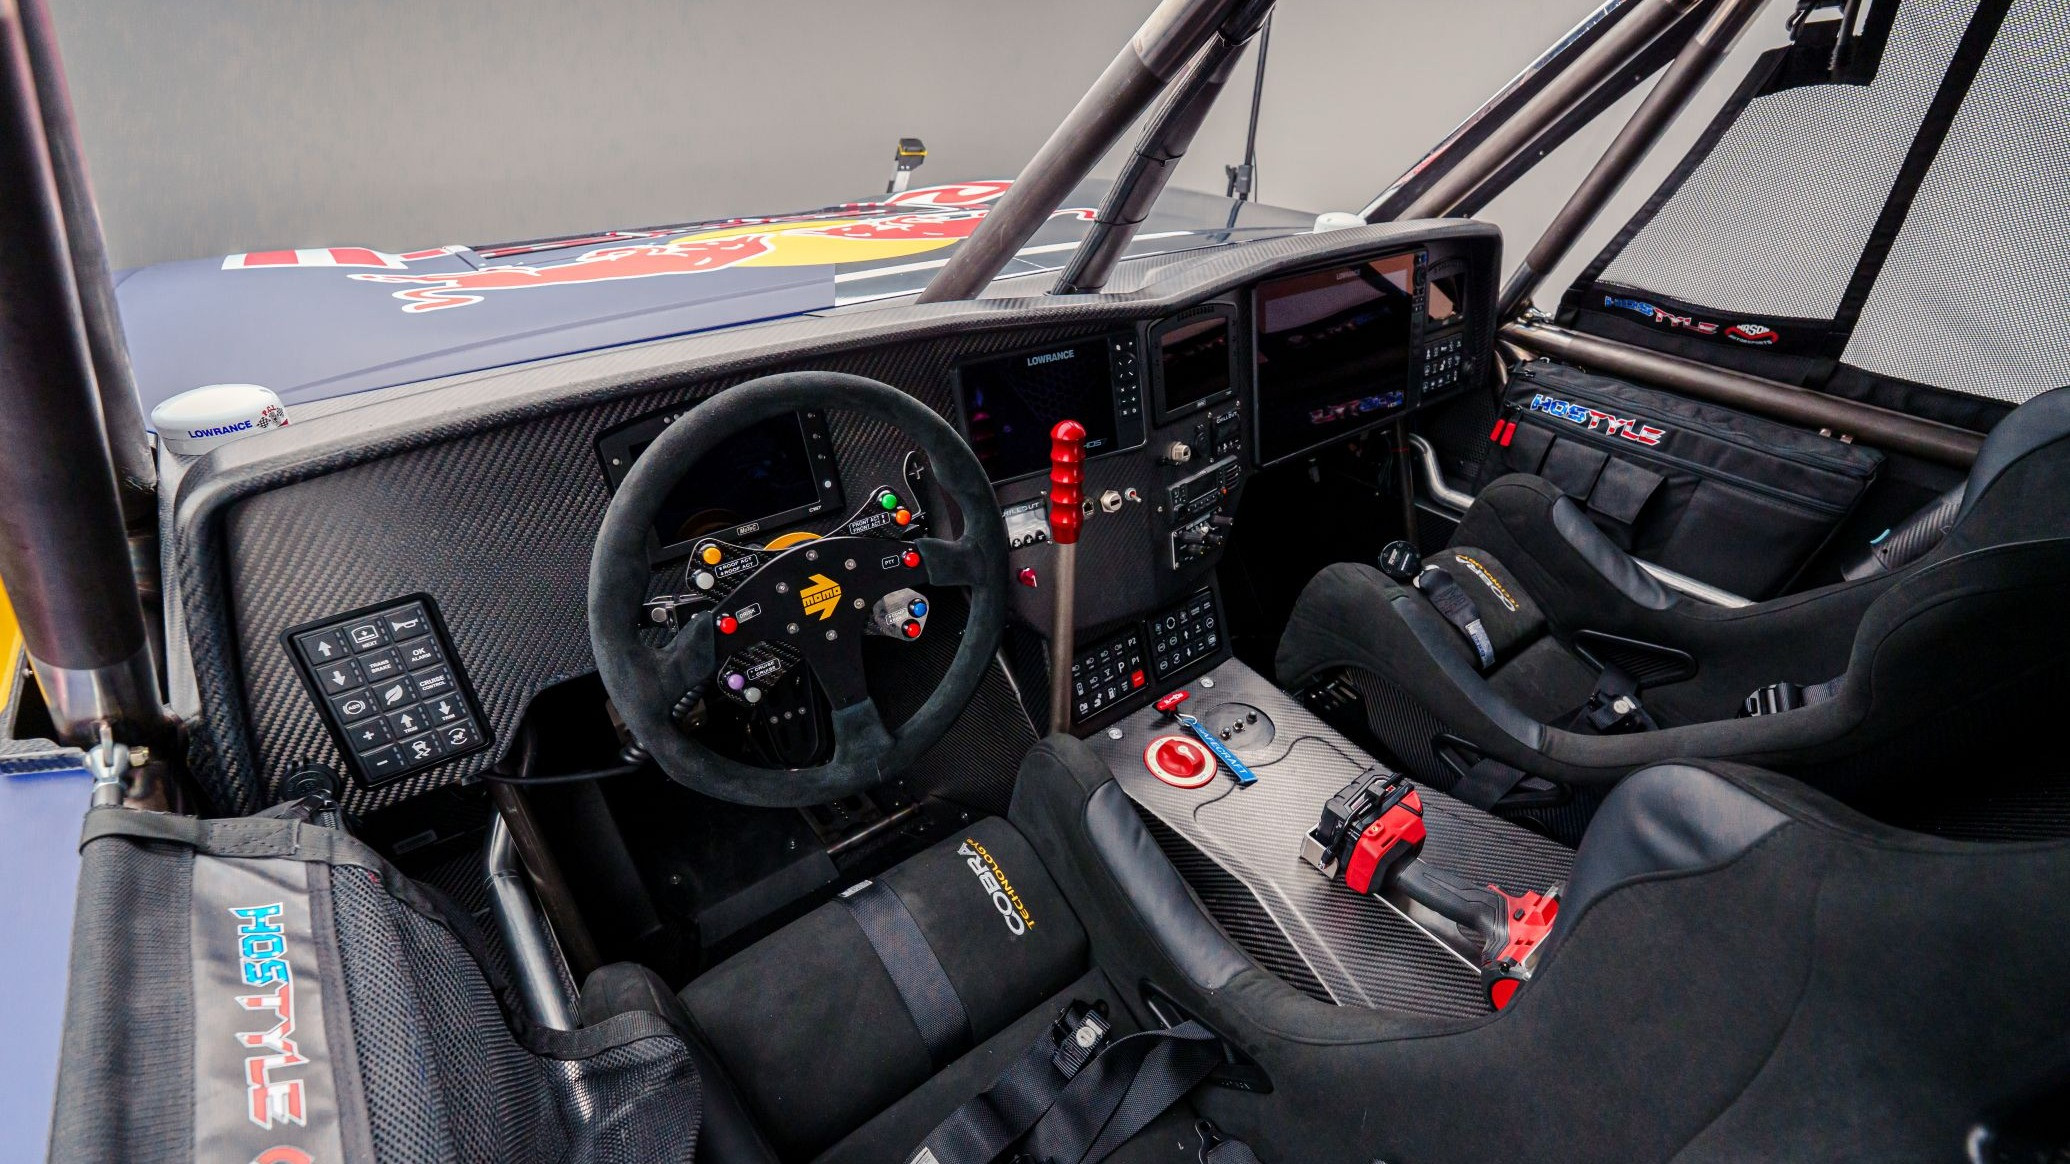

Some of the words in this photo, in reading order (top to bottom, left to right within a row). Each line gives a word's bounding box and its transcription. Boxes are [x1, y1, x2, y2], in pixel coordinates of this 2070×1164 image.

[1027, 349, 1075, 367] LOWRANCE
[1530, 394, 1666, 446] HOSTYLE
[188, 420, 253, 438] LOWRANCE
[1455, 555, 1516, 612] COBRA
[362, 641, 378, 649] NEXT
[1128, 637, 1137, 647] P2
[411, 652, 432, 662] ALARM
[412, 647, 426, 656] OK
[1131, 655, 1140, 666] P1
[419, 674, 446, 687] CRUISE
[422, 680, 447, 691] CONTROL
[957, 842, 1025, 936] COBRA
[228, 902, 310, 1131] HOSTYLE
